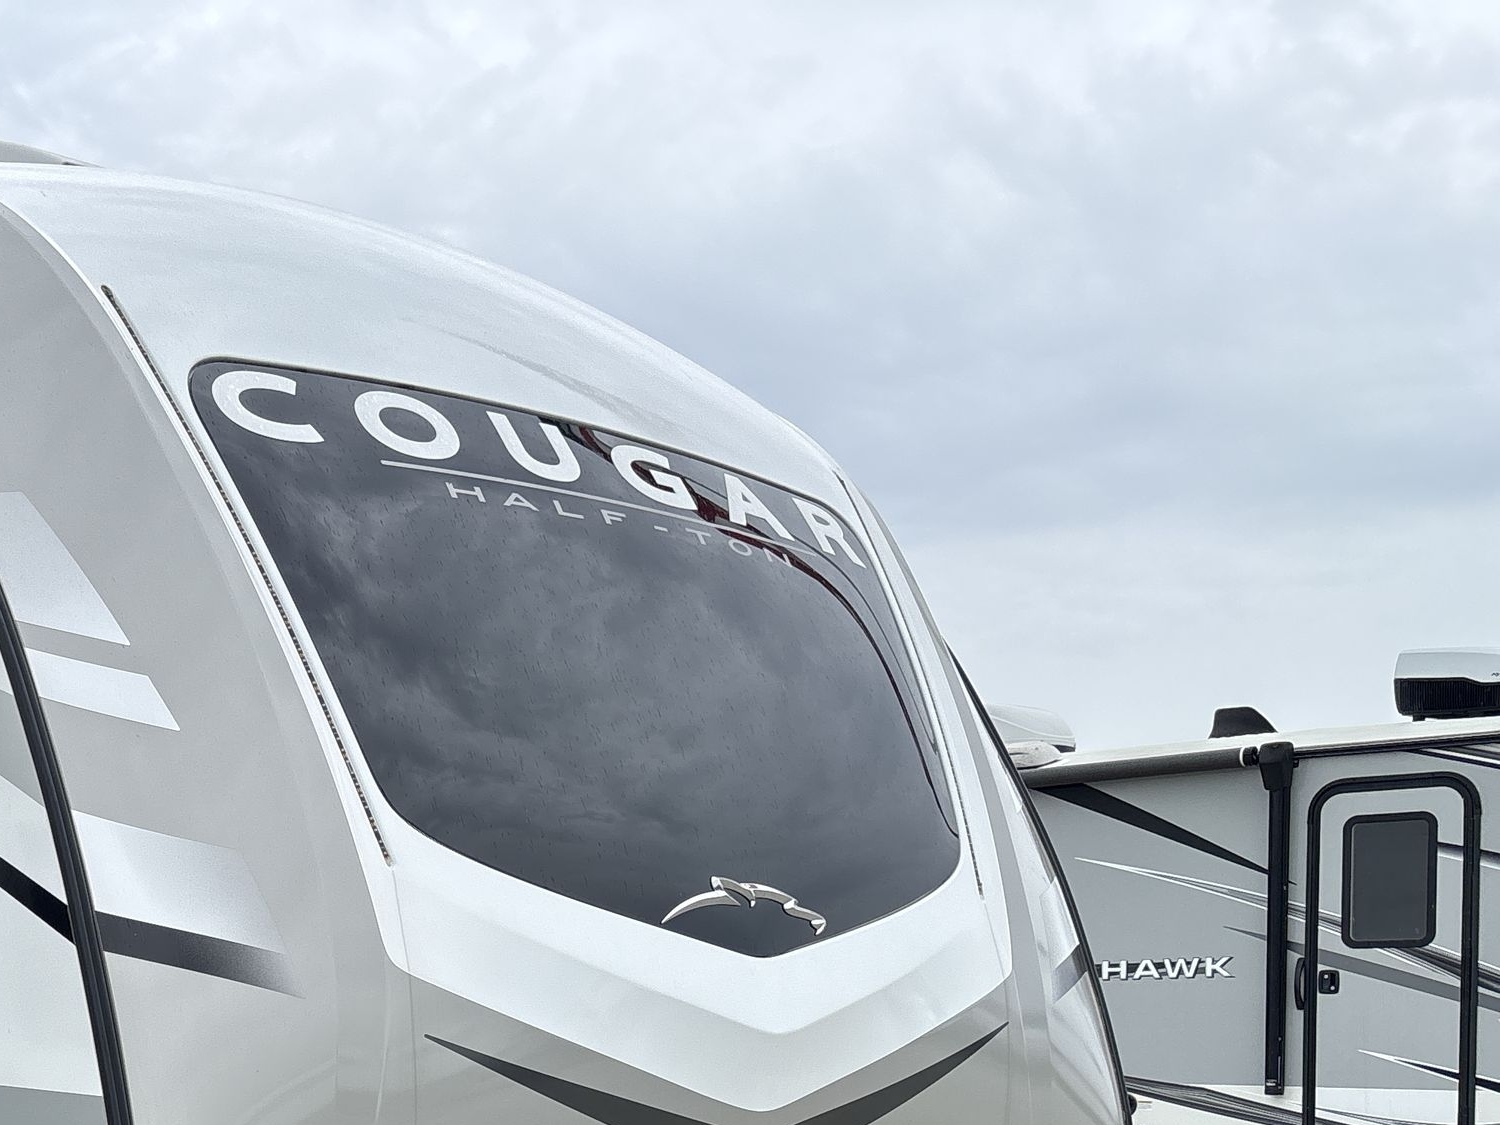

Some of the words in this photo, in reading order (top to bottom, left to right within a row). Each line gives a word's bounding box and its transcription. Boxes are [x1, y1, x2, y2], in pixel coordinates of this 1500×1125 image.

[211, 369, 867, 569] COUGAR
[444, 481, 794, 568] HALF-TON
[1101, 956, 1235, 981] HAWK
